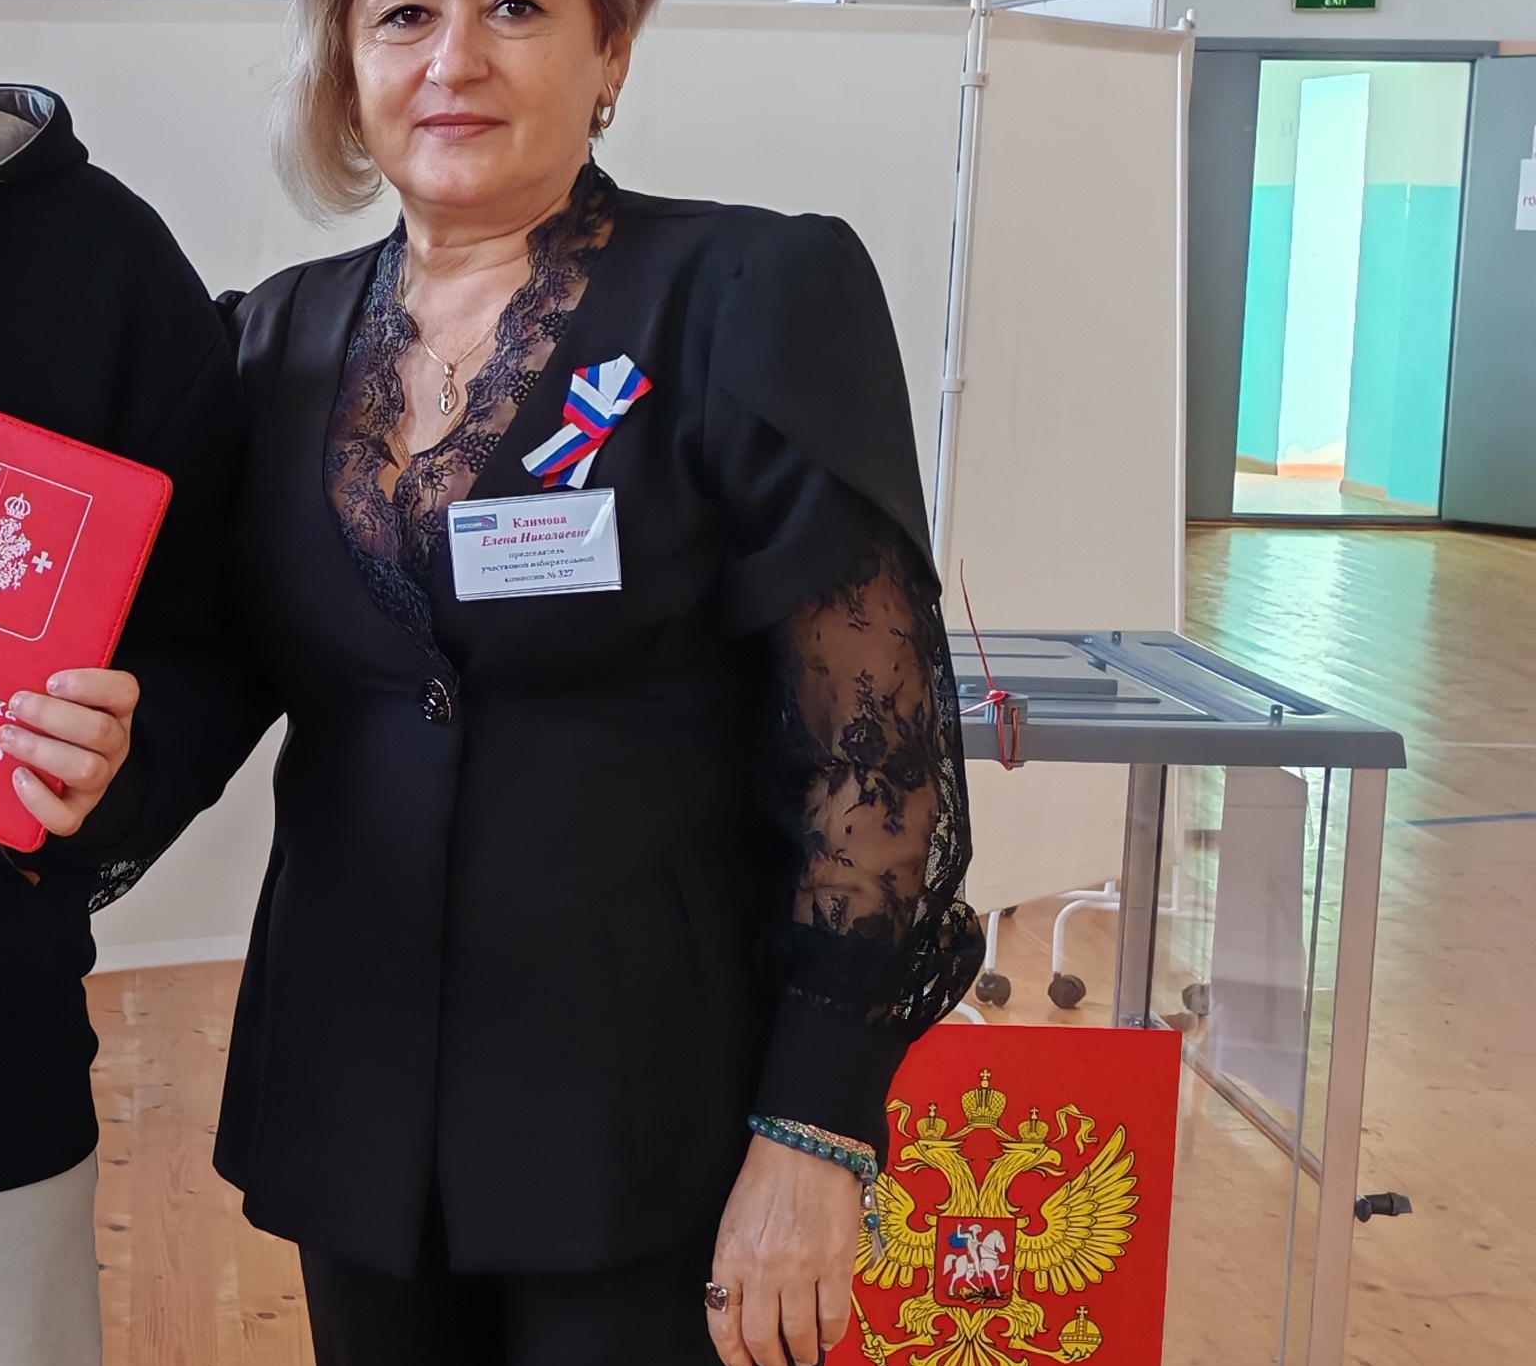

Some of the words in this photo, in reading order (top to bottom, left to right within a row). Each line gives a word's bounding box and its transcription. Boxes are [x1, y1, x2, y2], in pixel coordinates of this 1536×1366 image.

[513, 516, 567, 529] Климова
[482, 535, 517, 547] Елена
[508, 548, 565, 561] председатель
[481, 561, 529, 574] участковой
[530, 555, 595, 568] избирательной
[557, 568, 574, 578] 327
